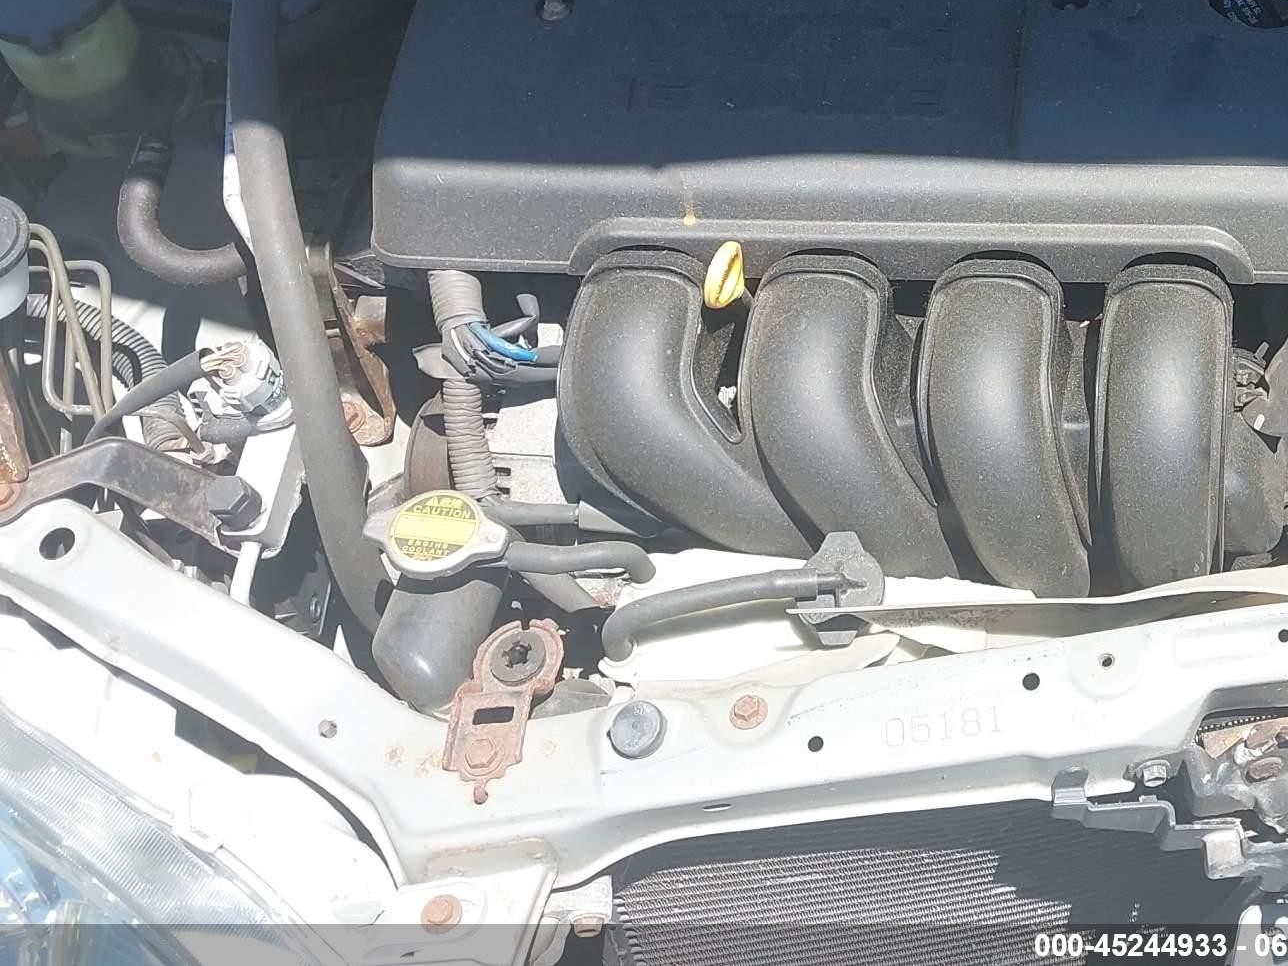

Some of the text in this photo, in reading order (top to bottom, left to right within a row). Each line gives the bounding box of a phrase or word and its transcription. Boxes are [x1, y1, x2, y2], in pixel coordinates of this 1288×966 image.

[413, 505, 470, 519] CAUTION
[407, 539, 449, 550] ENGINE
[402, 545, 450, 557] COOLANT
